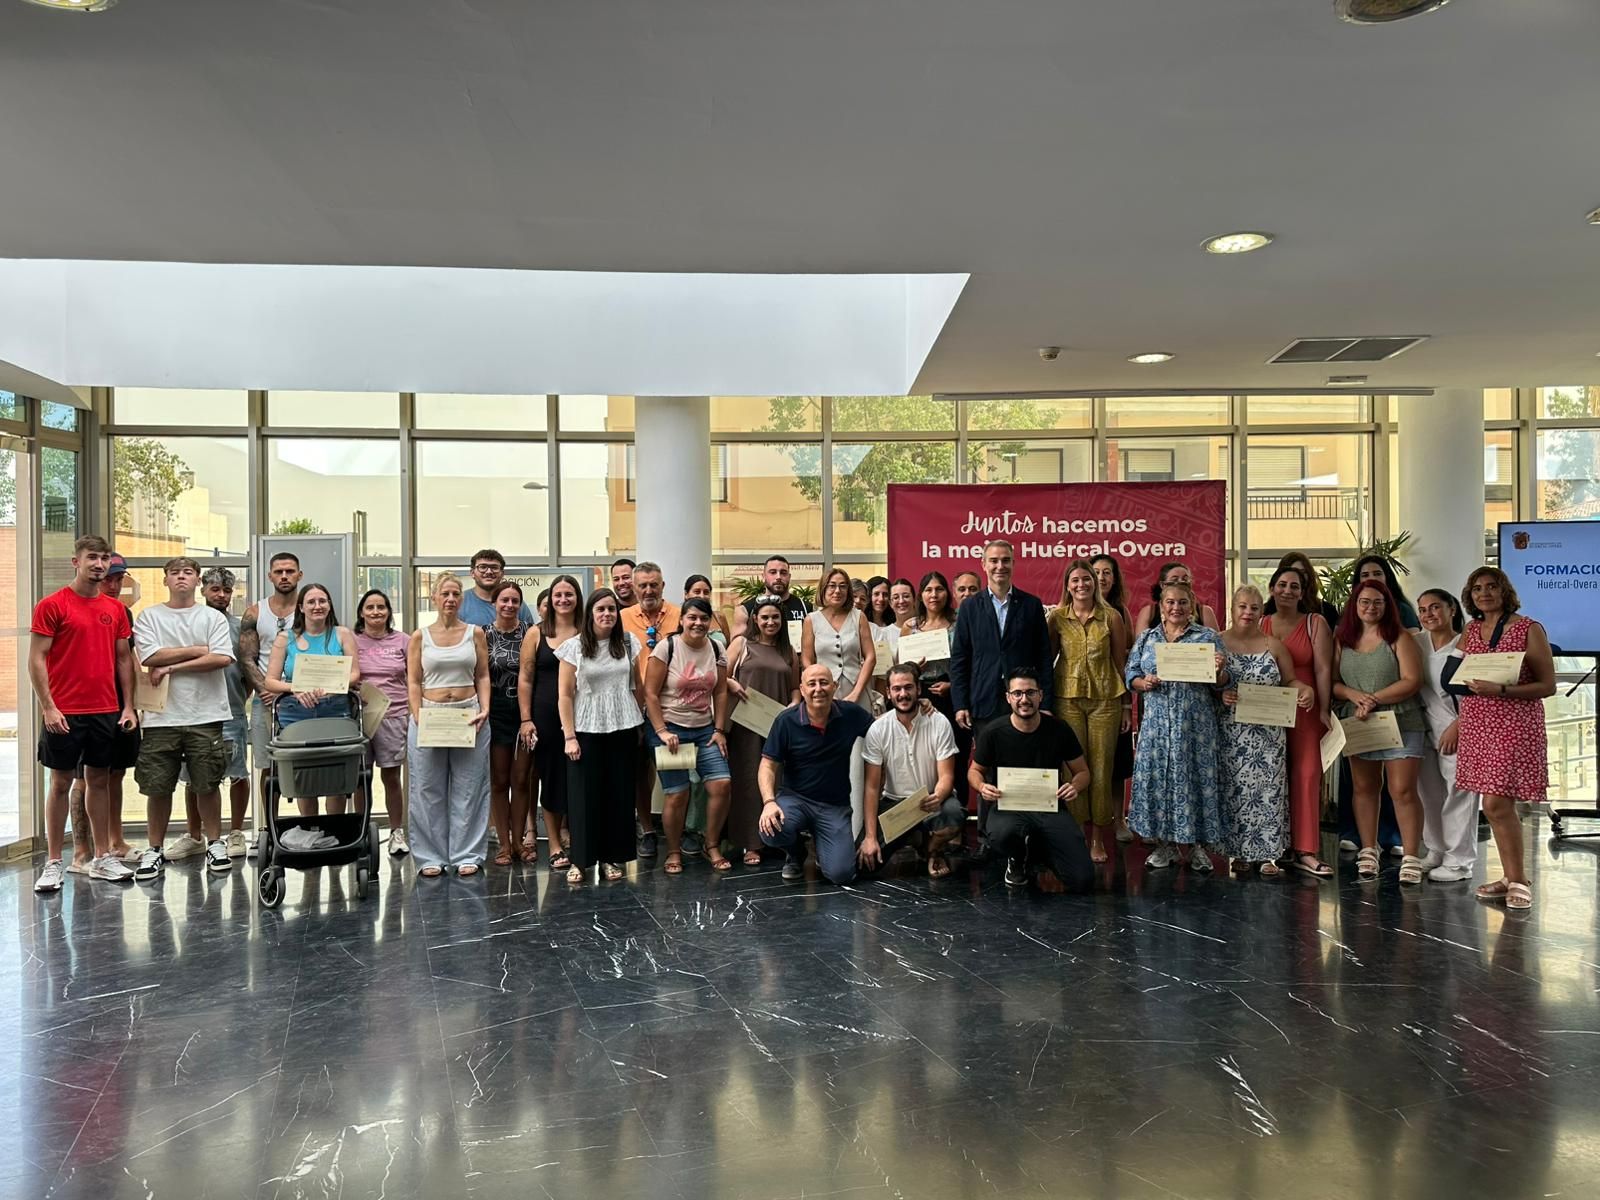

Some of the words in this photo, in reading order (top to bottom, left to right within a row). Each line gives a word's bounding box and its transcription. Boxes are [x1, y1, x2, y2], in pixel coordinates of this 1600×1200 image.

[961, 510, 1037, 536] Juntos
[1042, 516, 1147, 533] hacemos
[922, 541, 941, 558] la
[1021, 540, 1186, 558] Huércal-Overa
[1537, 579, 1598, 589] Huércal-Overa
